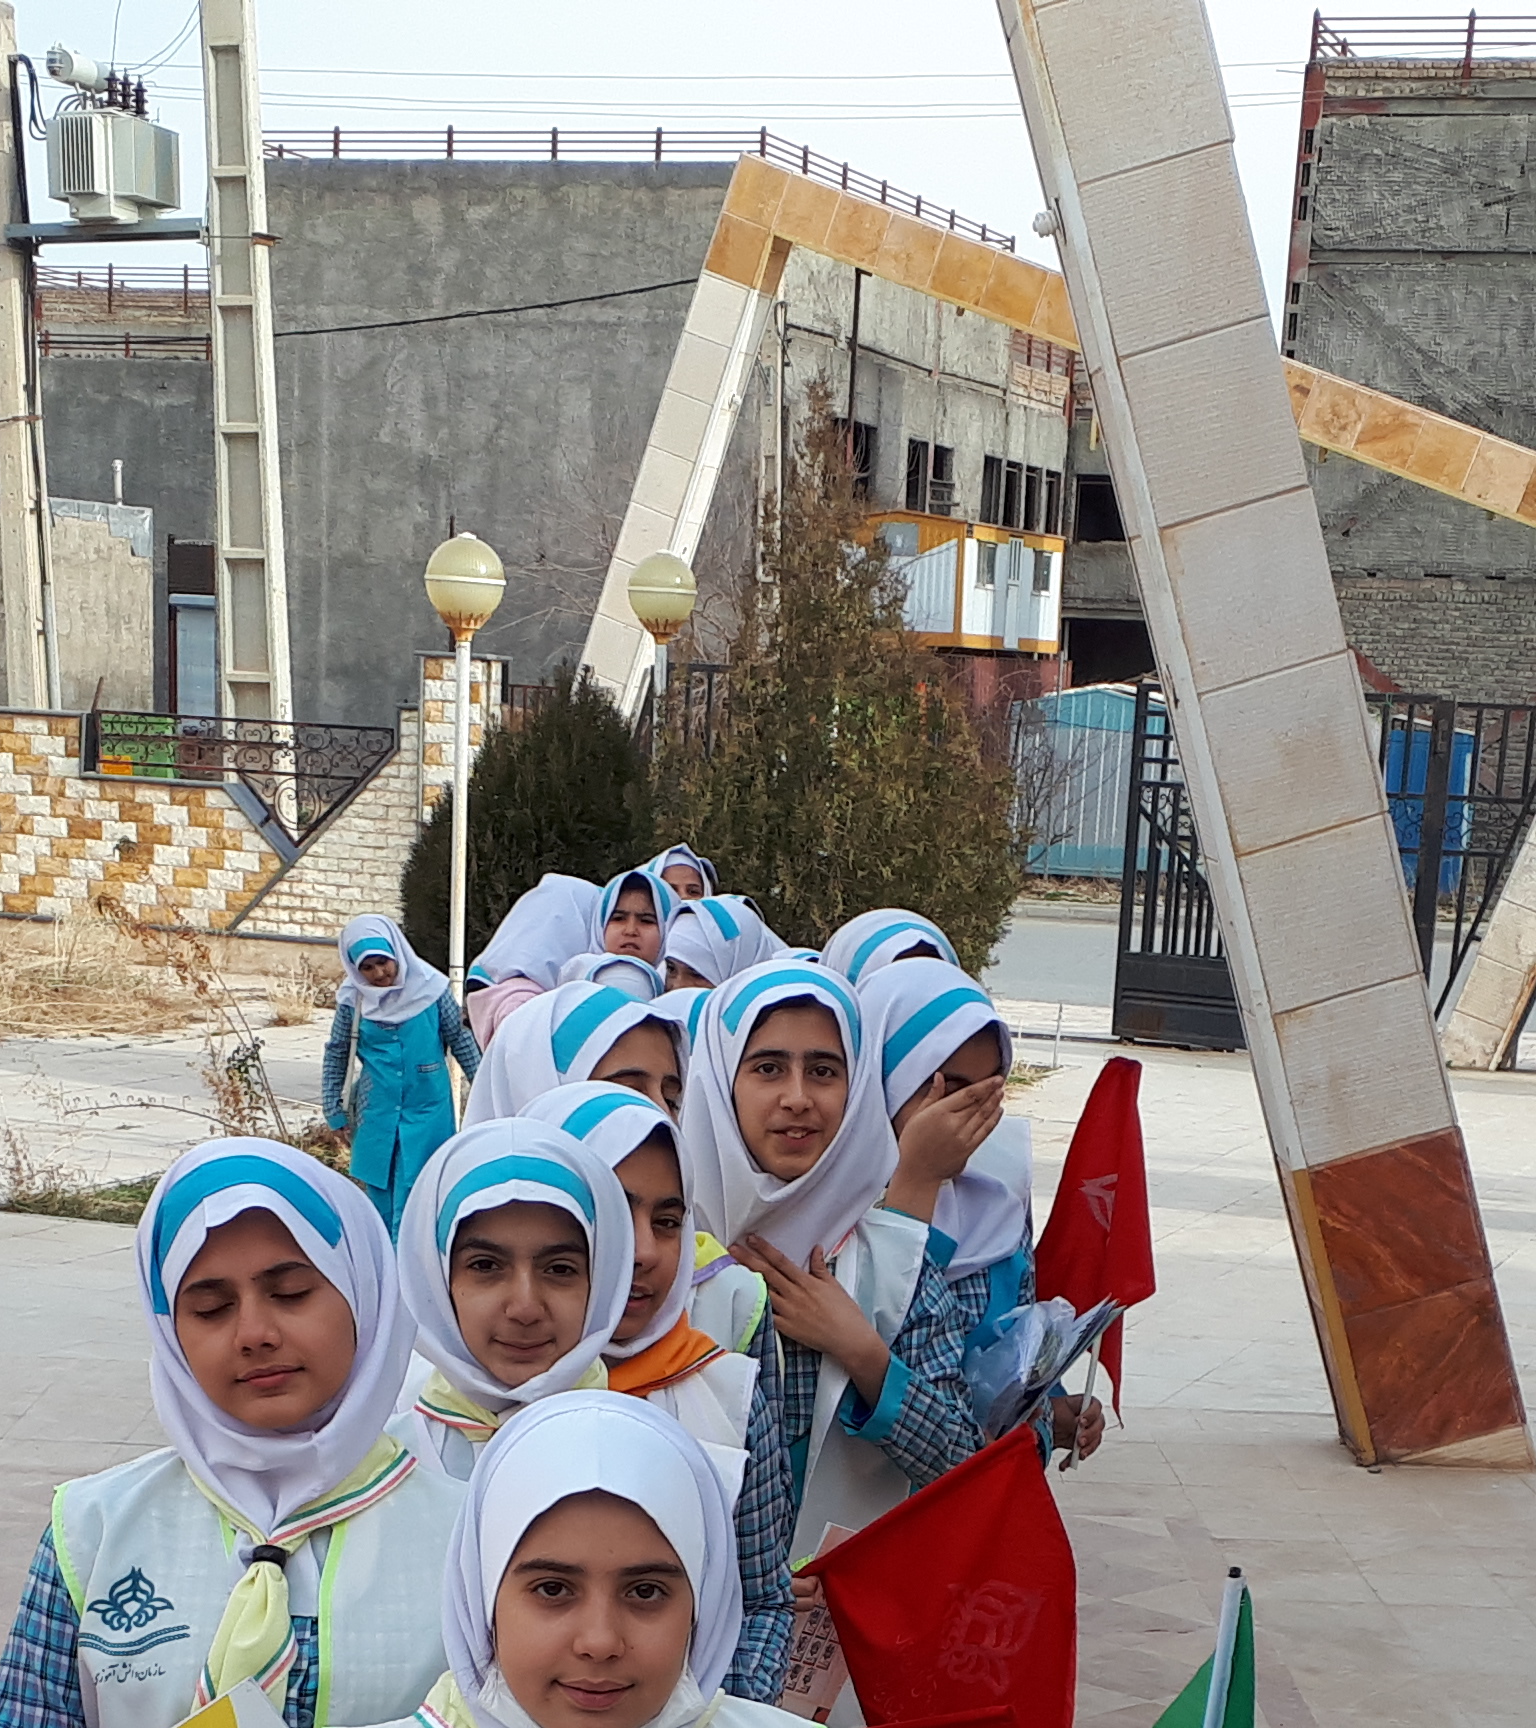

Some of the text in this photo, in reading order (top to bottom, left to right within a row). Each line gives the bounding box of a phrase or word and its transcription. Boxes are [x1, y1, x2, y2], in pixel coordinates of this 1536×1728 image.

[93, 1661, 166, 1686] سازمان دانش آموزی
